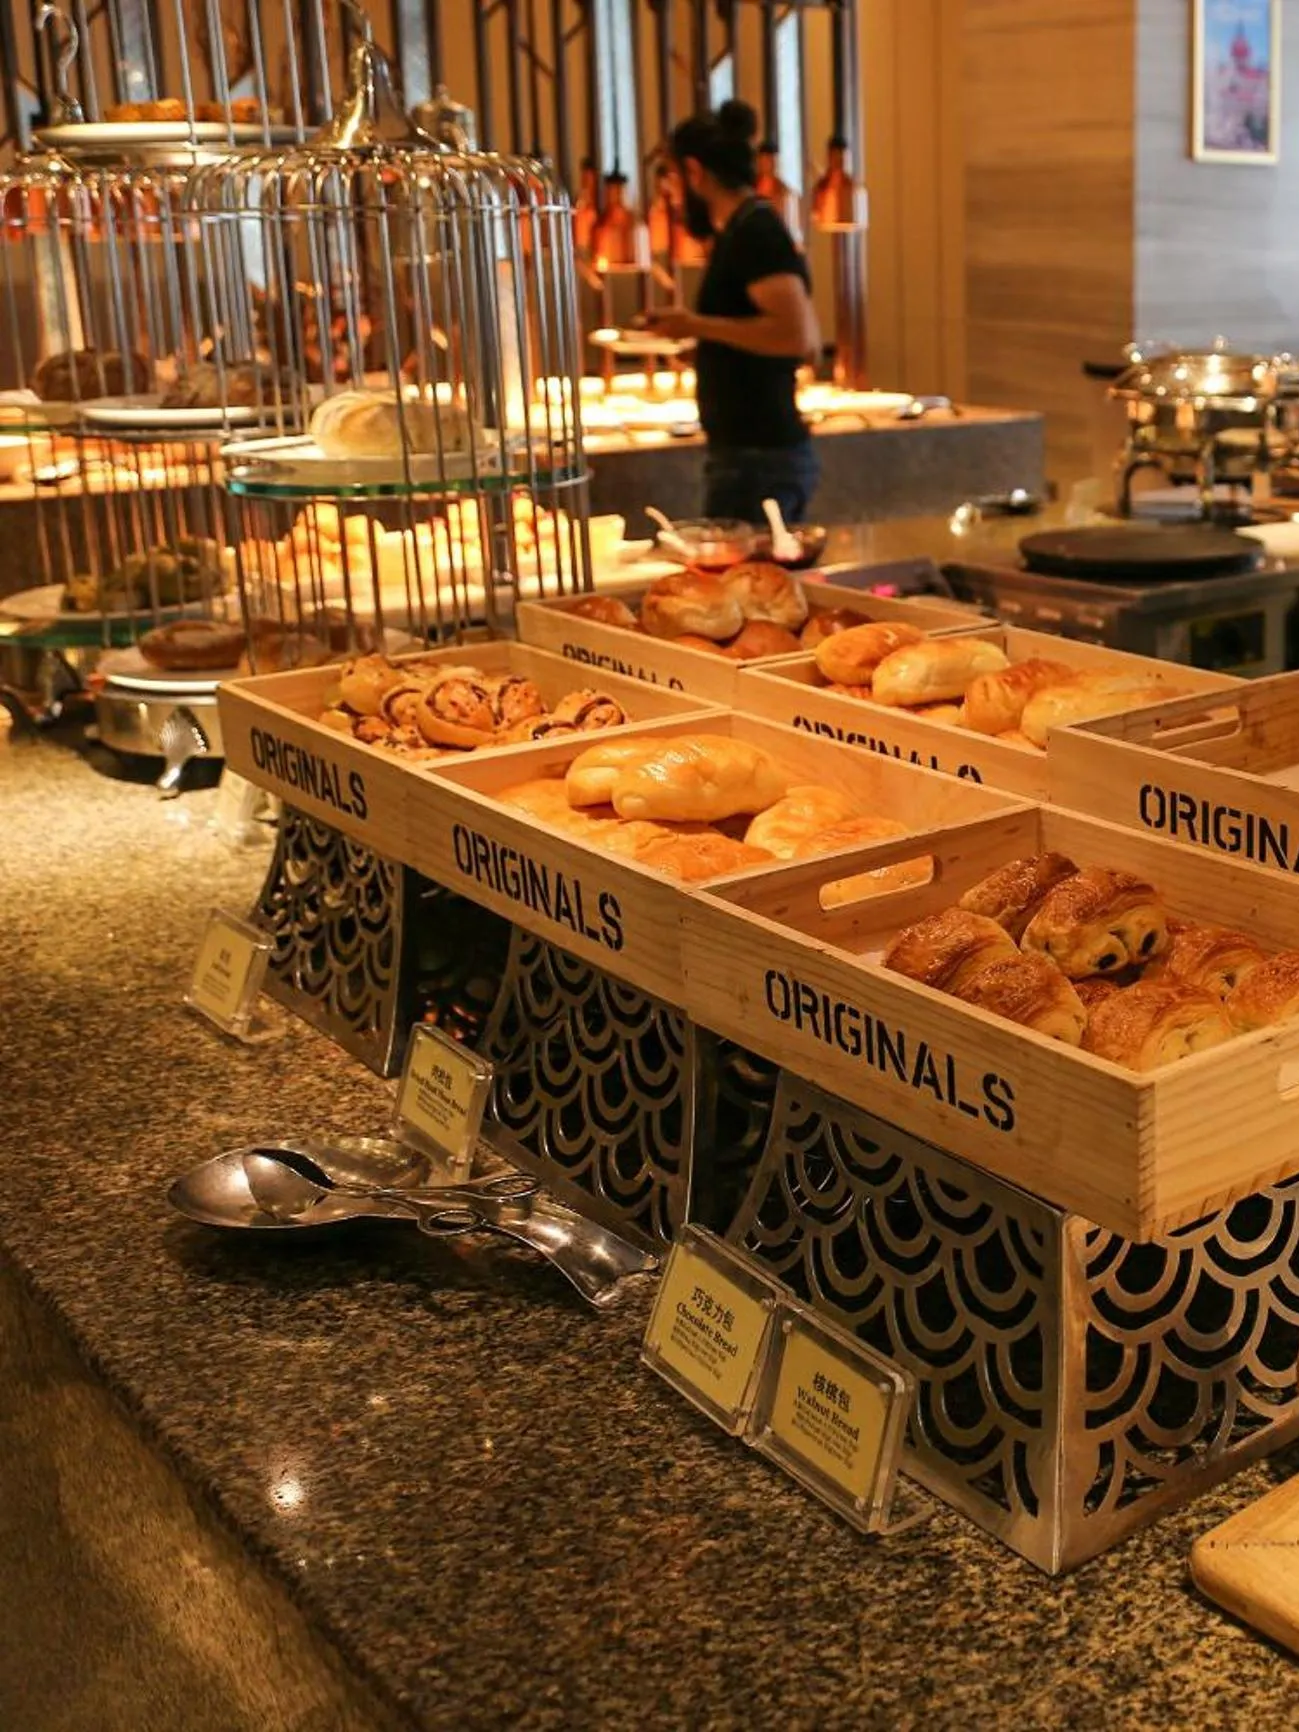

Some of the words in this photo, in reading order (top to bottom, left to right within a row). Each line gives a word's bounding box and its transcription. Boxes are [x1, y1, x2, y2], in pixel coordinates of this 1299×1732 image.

[251, 727, 368, 820] ORIGINALS
[453, 824, 623, 951] ORIGINALS
[765, 970, 1015, 1132] ORIGINALS
[676, 1302, 715, 1334] Chocolate
[713, 1329, 738, 1357] Bread
[797, 1386, 832, 1418] Walnut
[831, 1412, 859, 1442] Bread
